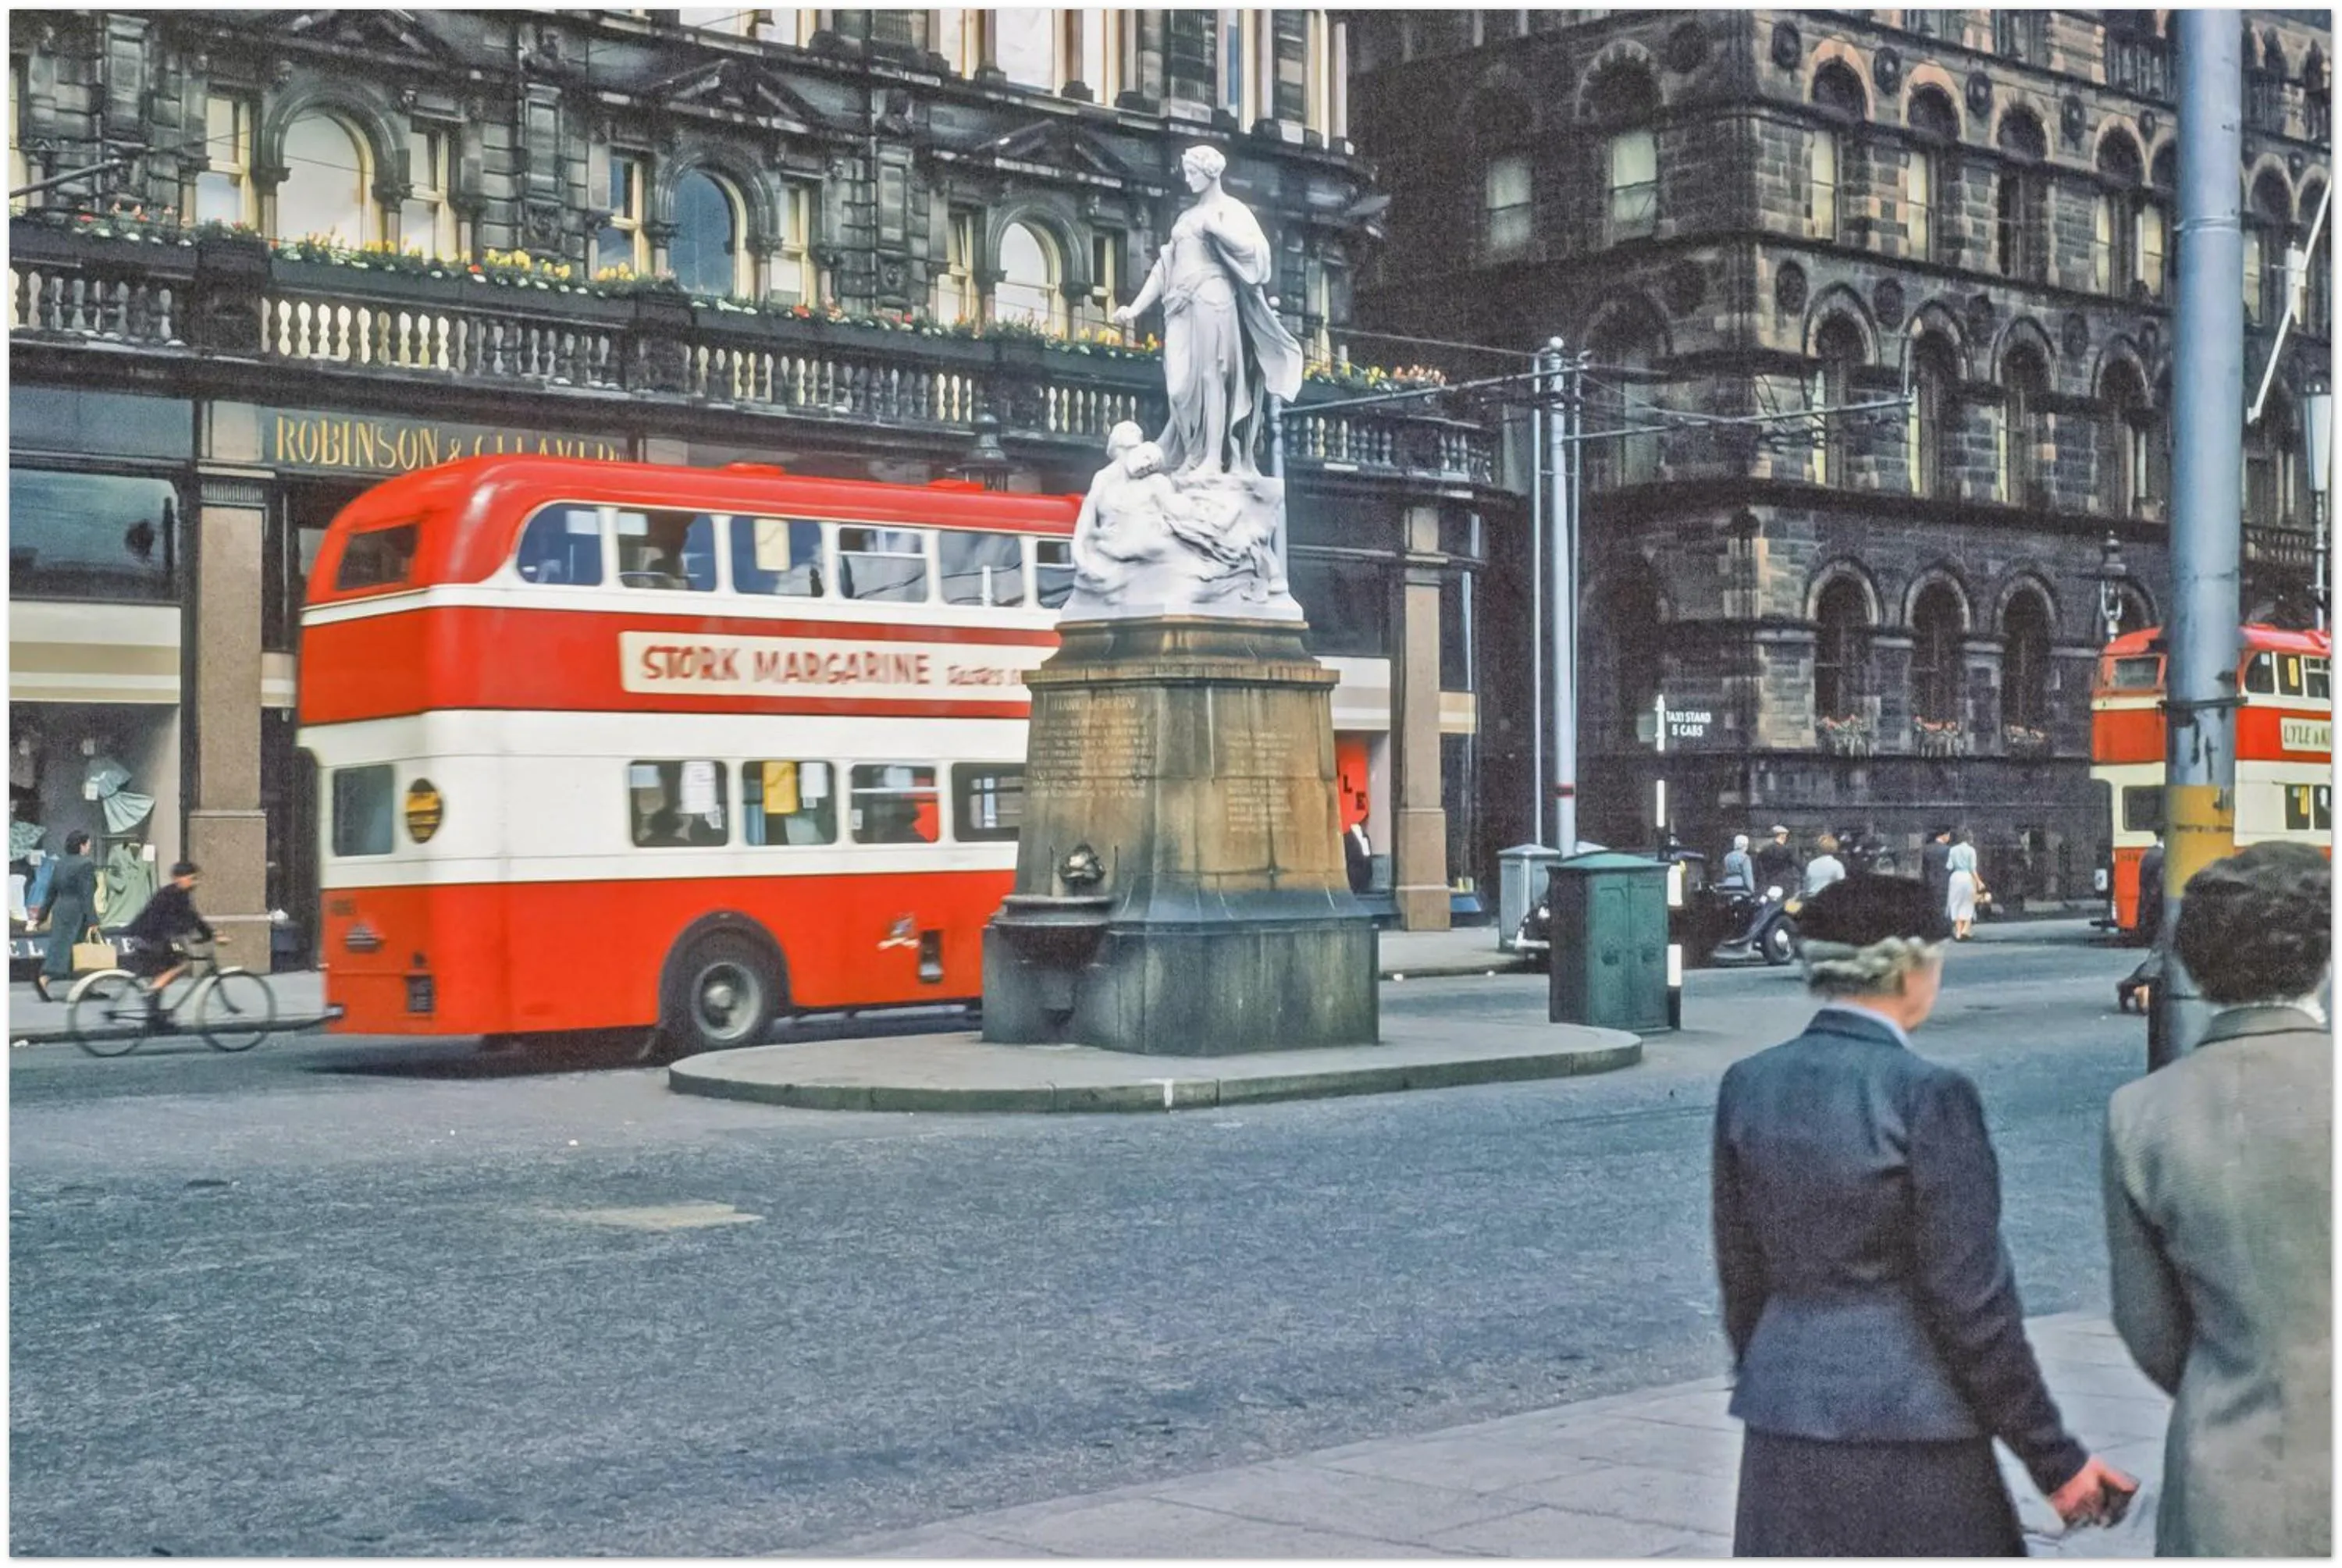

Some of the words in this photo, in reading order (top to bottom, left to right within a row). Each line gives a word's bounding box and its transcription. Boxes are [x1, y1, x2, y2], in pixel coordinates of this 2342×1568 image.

[276, 416, 440, 470] ROBINSON
[641, 645, 739, 681] STORK
[753, 651, 931, 684] MARGARINE
[1666, 710, 1684, 723] TAXI
[1685, 711, 1711, 724] STAND
[1672, 724, 1678, 736] 5
[1680, 724, 1703, 738] CABS
